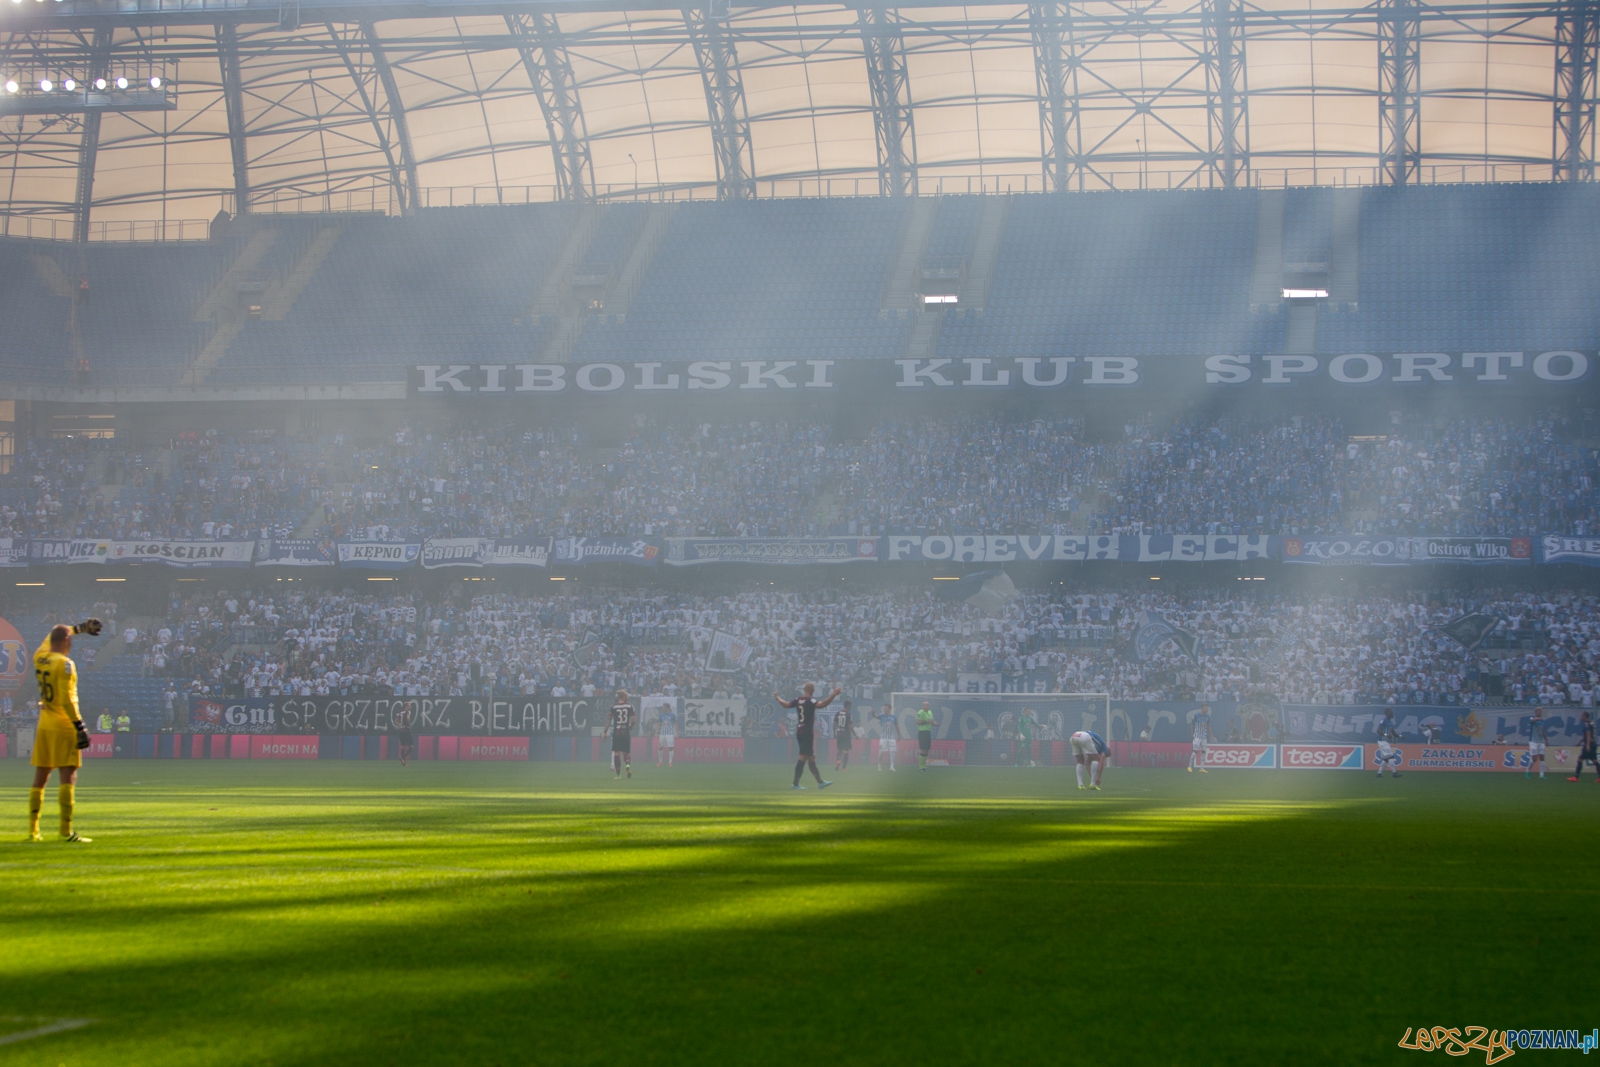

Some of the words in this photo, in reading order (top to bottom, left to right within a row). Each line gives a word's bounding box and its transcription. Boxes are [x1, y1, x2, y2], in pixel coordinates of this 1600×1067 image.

[416, 360, 835, 392] KIBOLSKI
[895, 357, 1138, 387] KLUB
[1204, 350, 1600, 384] SPORTO
[43, 543, 98, 558] RAWICZ
[133, 543, 225, 559] KOŚCIAN
[353, 547, 402, 560] KĘPNO
[888, 535, 1120, 562] FOREVER
[1137, 535, 1269, 562] LECH
[1304, 541, 1394, 559] KOŁO
[1429, 543, 1471, 557] Ostrów
[225, 702, 276, 726] Gni
[616, 708, 629, 724] 33
[685, 702, 736, 728] Lech
[798, 705, 805, 723] 3
[837, 714, 847, 728] 10
[262, 744, 299, 754] MOCNI
[303, 744, 318, 754] NA
[471, 745, 508, 756] MOCNI
[512, 745, 529, 756] NA
[685, 747, 724, 758] MOCNI
[728, 747, 744, 758] NA
[904, 749, 944, 760] MONI
[948, 749, 965, 760] NA
[1205, 749, 1251, 764] tesa
[1287, 748, 1337, 764] tesa
[1422, 748, 1485, 760] ZAKŁADY
[1173, 752, 1191, 762] NA
[1409, 760, 1496, 769] BUKMACHERSKIE
